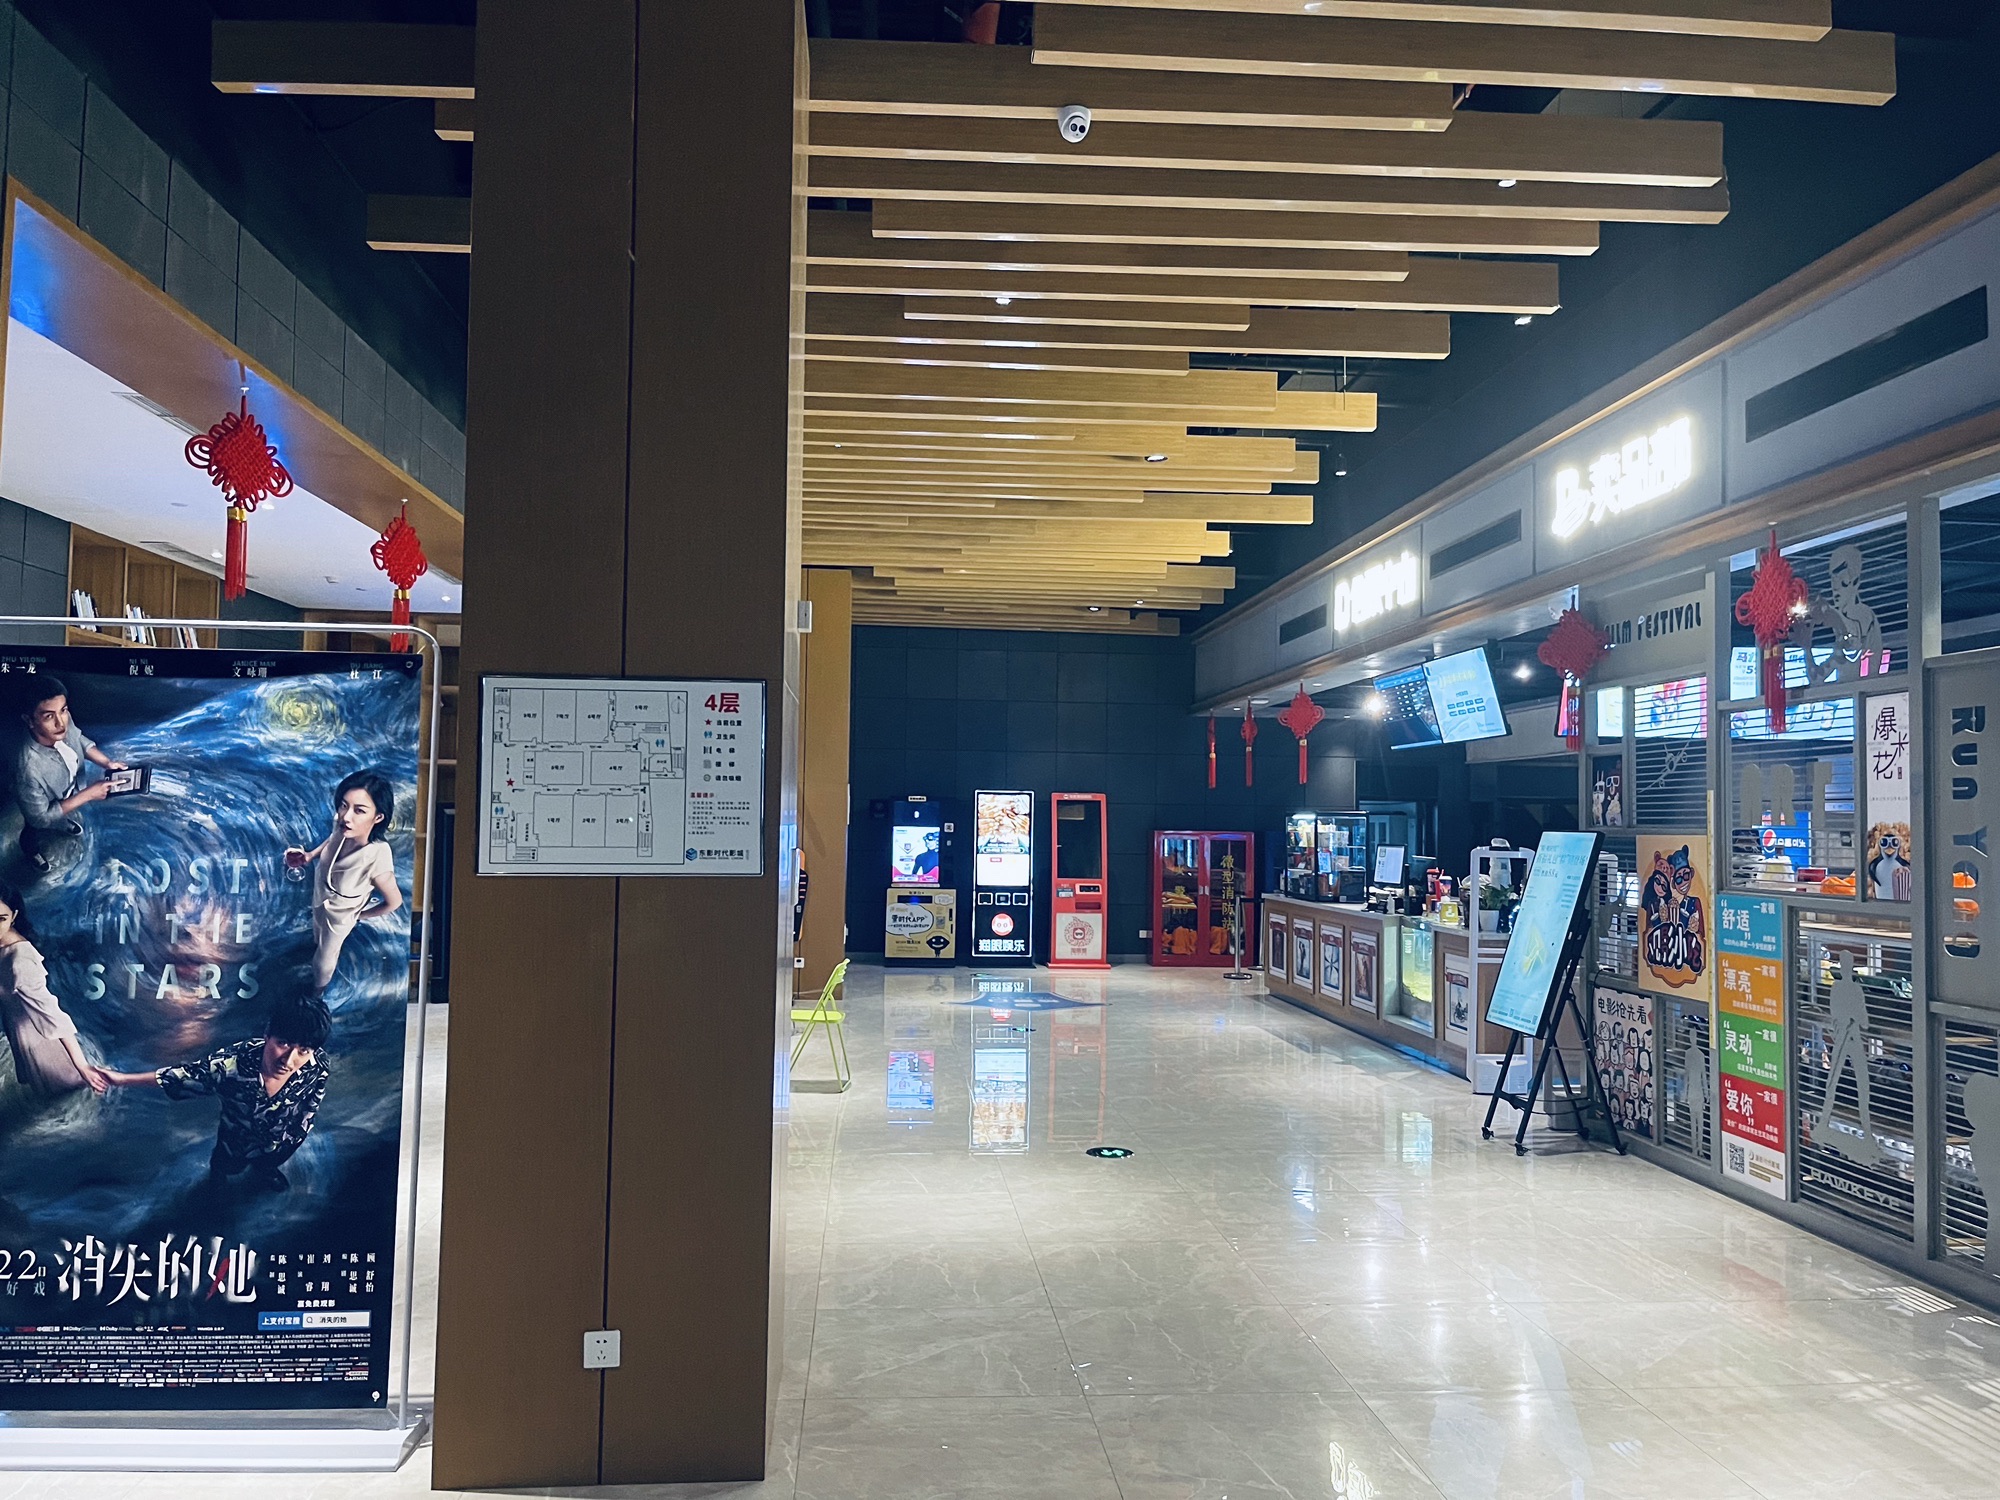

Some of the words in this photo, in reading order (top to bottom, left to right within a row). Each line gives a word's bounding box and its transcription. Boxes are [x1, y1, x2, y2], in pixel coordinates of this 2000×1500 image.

[0, 662, 37, 674] 朱一龙
[704, 693, 740, 714] 4层
[1873, 706, 1908, 780] 爆米花
[116, 858, 248, 894] LOST
[97, 914, 139, 944] IN
[165, 913, 252, 943] THE
[85, 963, 259, 999] STARS
[1598, 997, 1646, 1024] 电影抢先看
[1810, 1167, 1900, 1208] HAWKEYE
[54, 1233, 258, 1306] 消失的她
[319, 1316, 347, 1324] 消失的她
